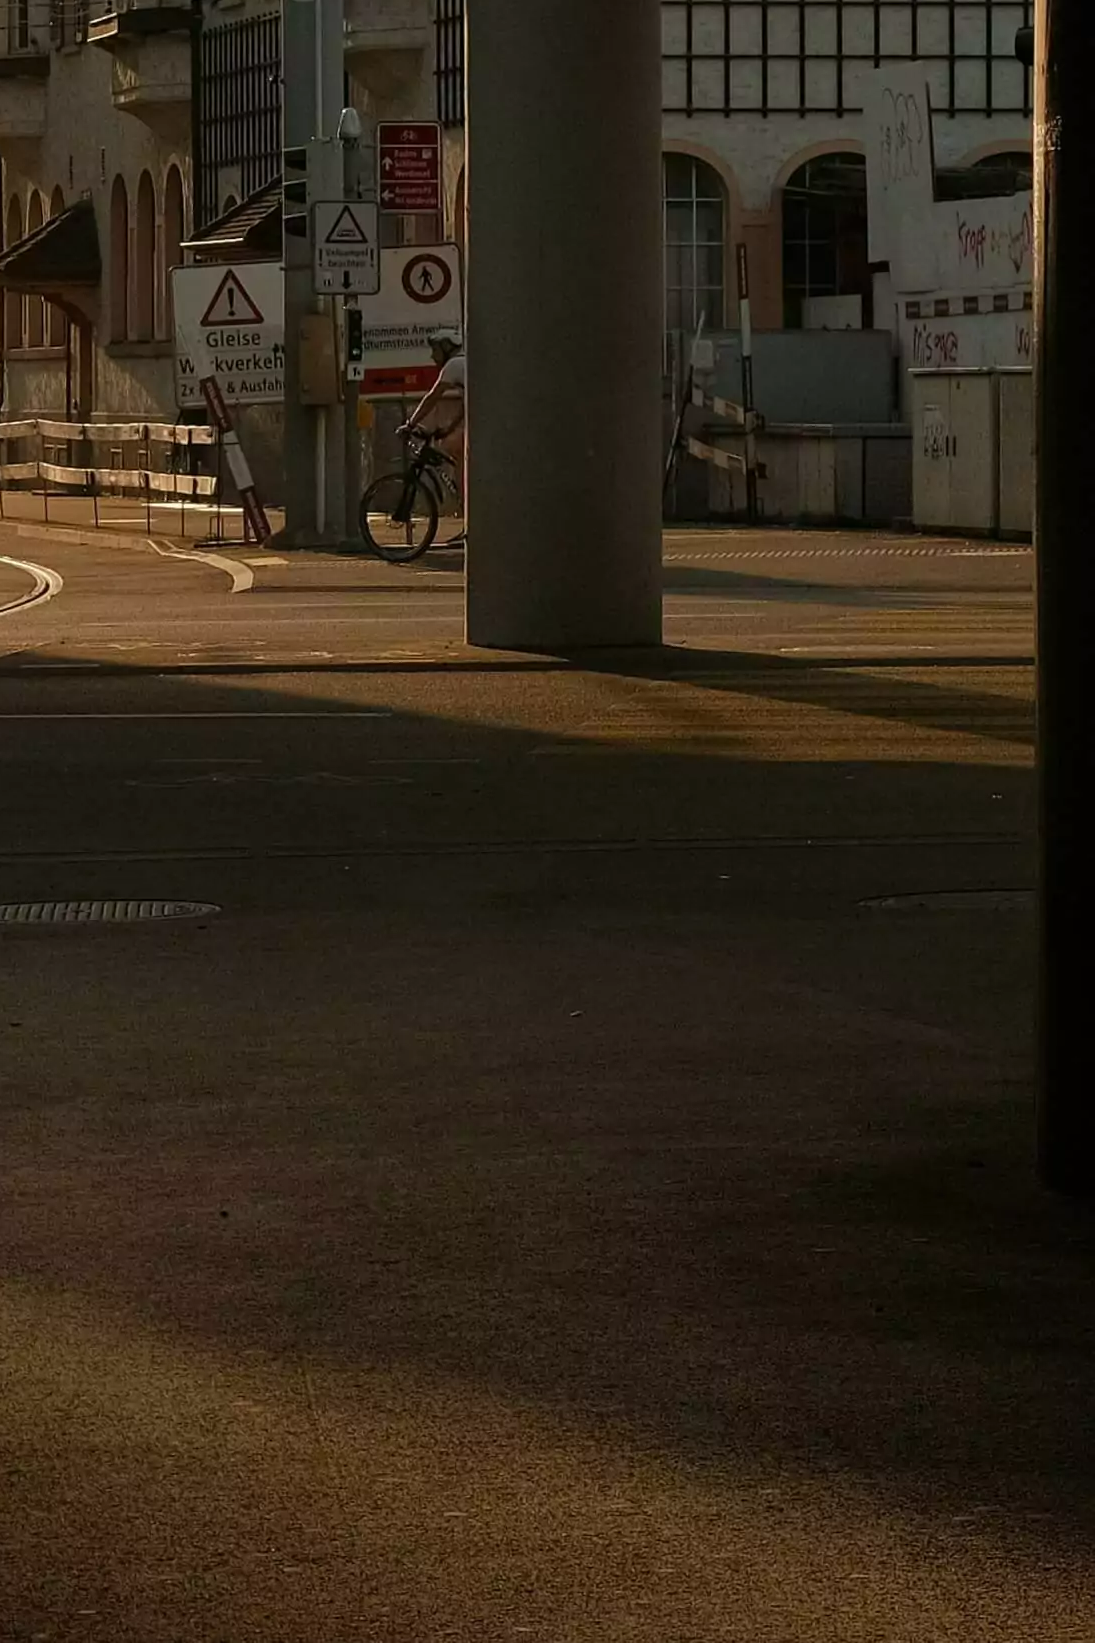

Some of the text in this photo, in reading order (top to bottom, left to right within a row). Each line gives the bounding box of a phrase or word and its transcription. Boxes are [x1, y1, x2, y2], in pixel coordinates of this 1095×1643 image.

[206, 329, 261, 348] Gleise
[179, 353, 283, 374] Wkverkeh
[227, 381, 235, 393] &
